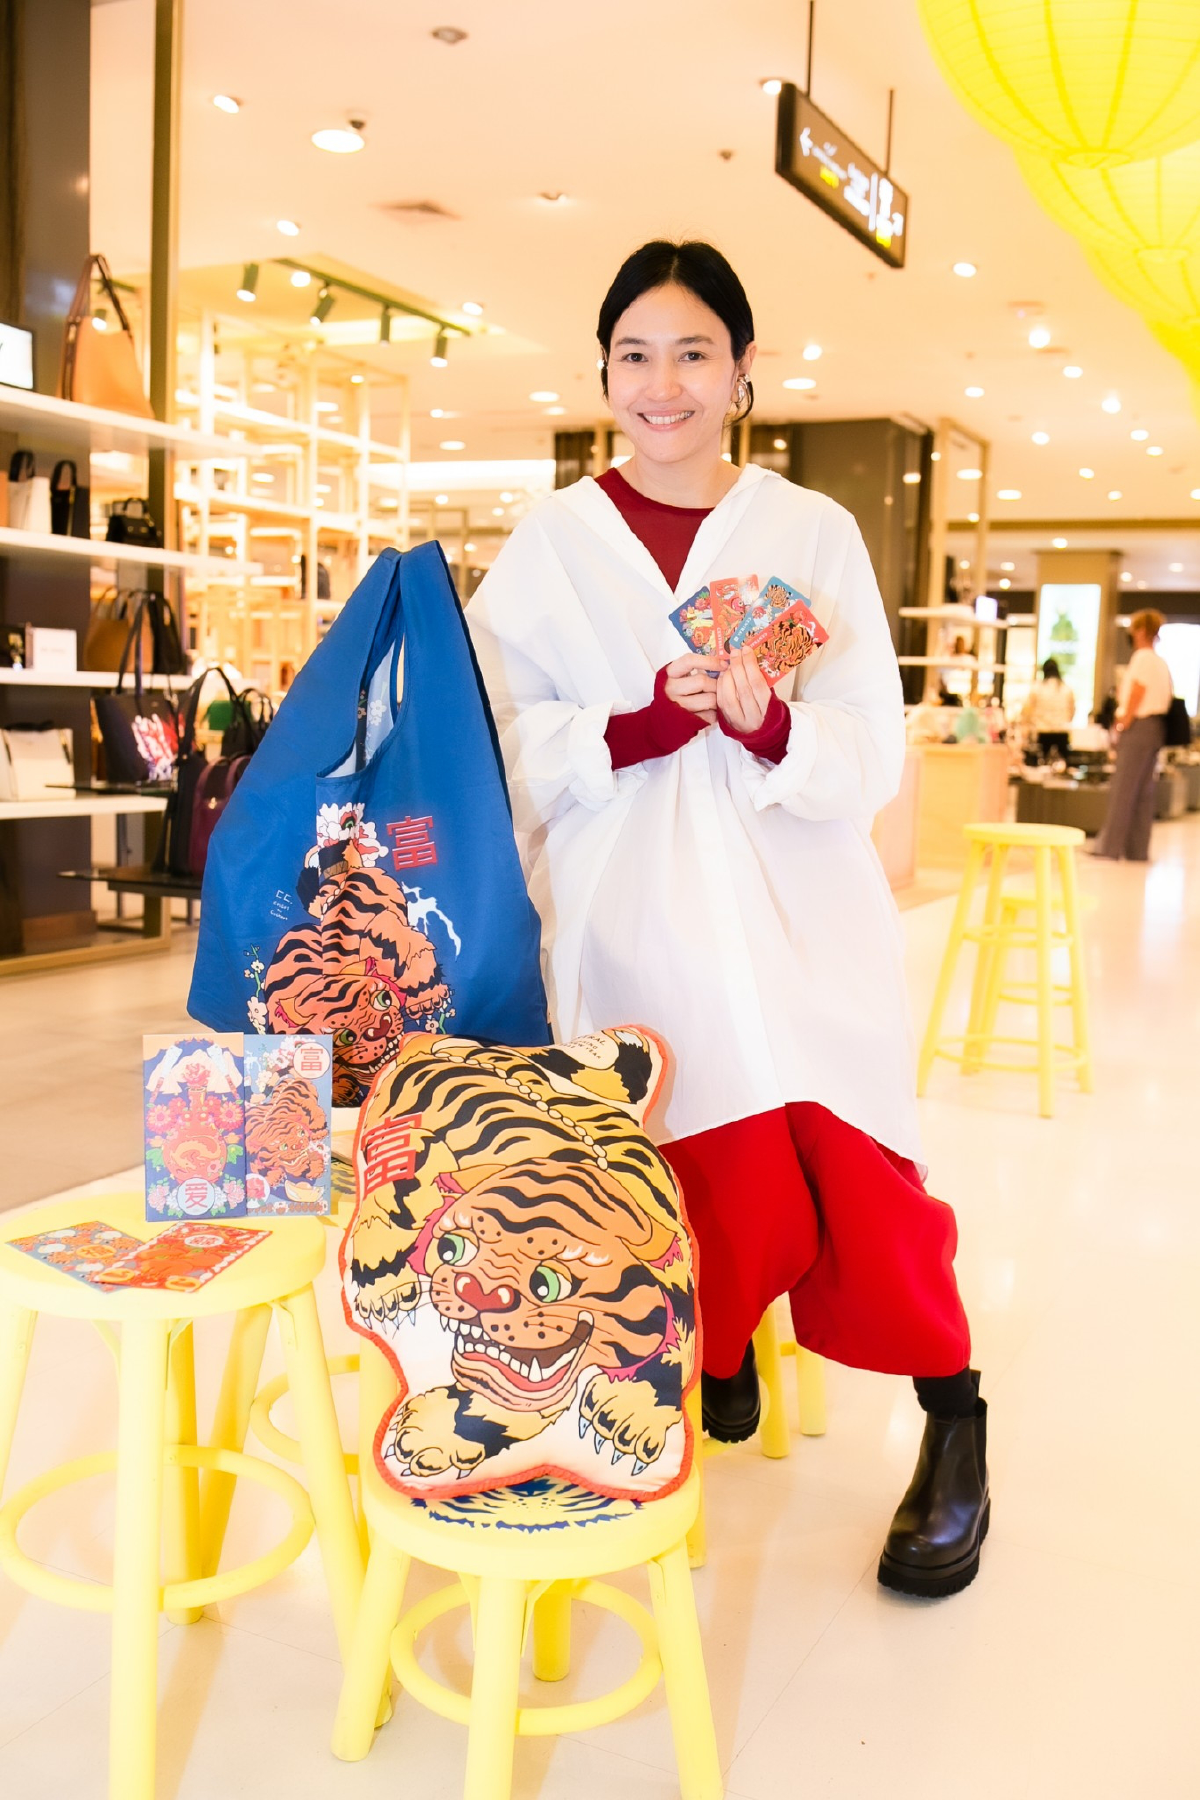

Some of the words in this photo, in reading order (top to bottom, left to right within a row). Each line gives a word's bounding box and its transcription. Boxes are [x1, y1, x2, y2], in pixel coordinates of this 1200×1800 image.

[386, 815, 437, 872] 富
[300, 1046, 324, 1071] 富
[360, 1112, 422, 1201] 富
